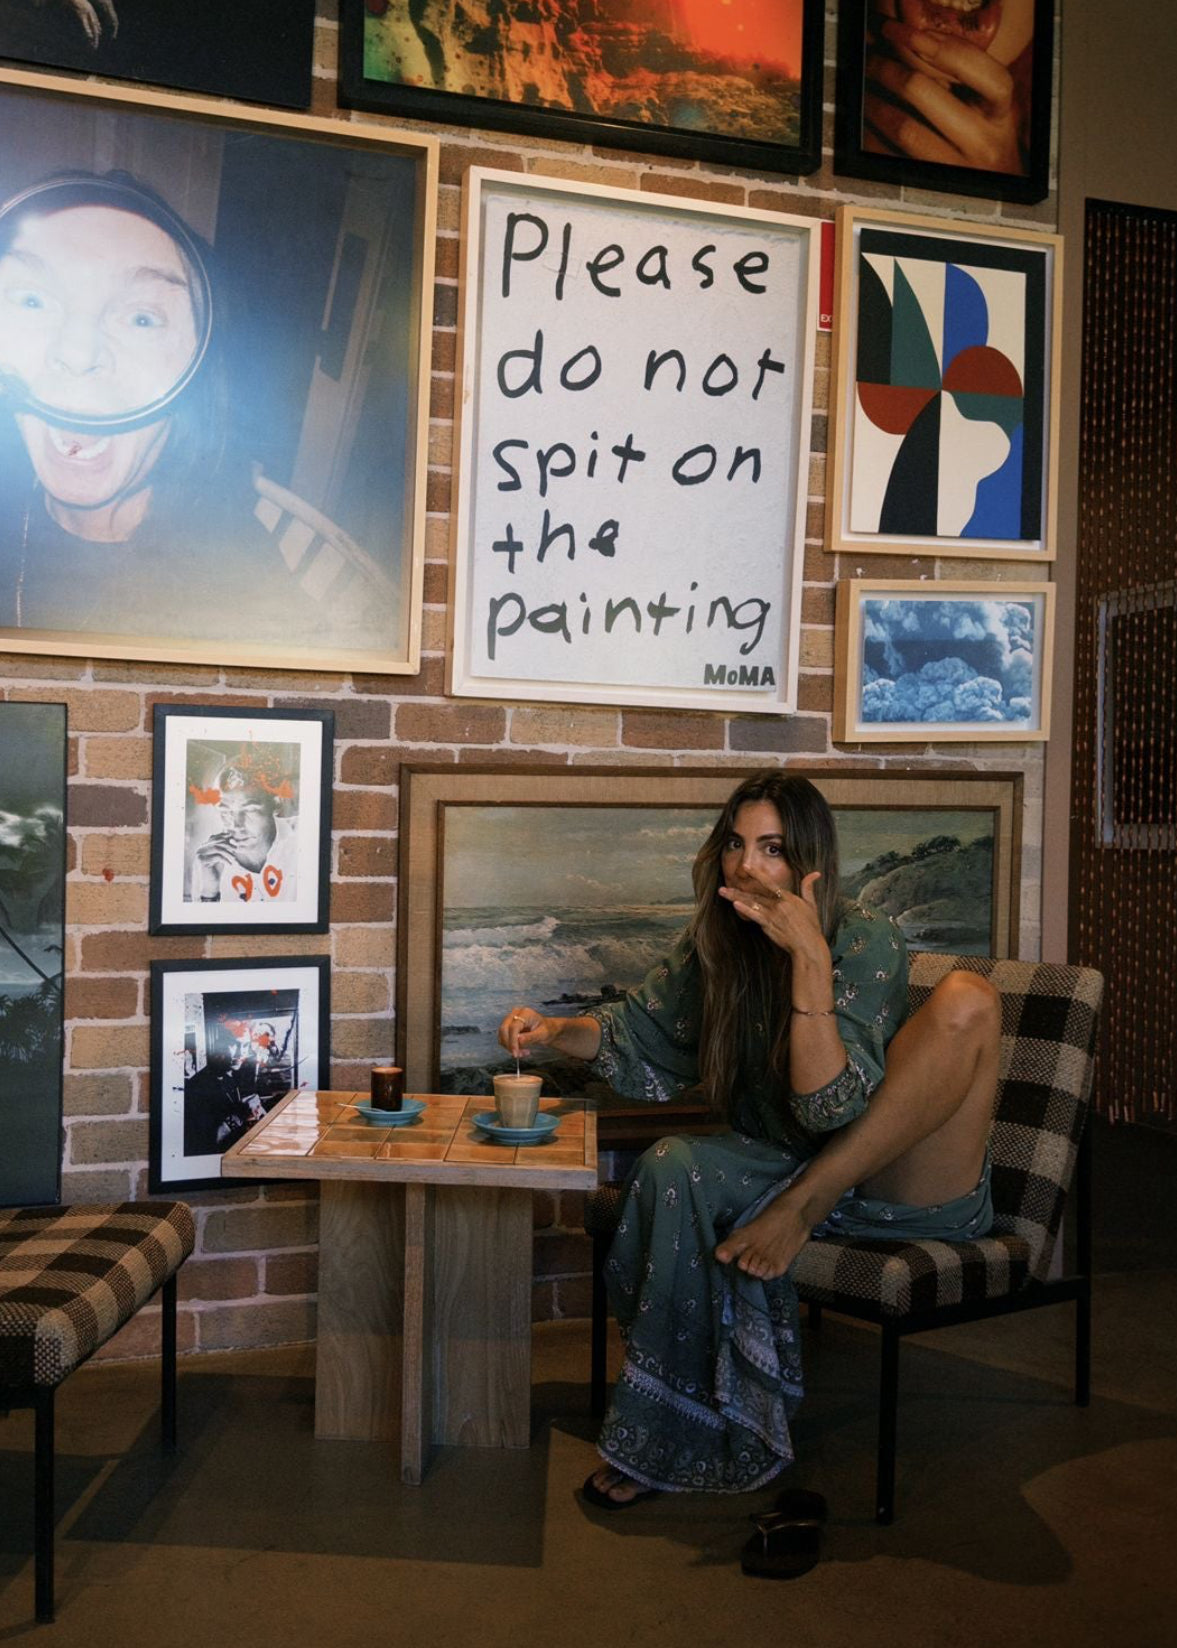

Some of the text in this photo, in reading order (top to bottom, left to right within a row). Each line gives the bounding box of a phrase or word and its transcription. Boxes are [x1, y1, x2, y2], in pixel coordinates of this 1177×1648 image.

[502, 212, 769, 300] Please
[497, 329, 785, 400] do not
[492, 430, 761, 497] spit on
[492, 509, 620, 573] the
[487, 581, 771, 660] painting
[704, 663, 776, 687] MoMA
